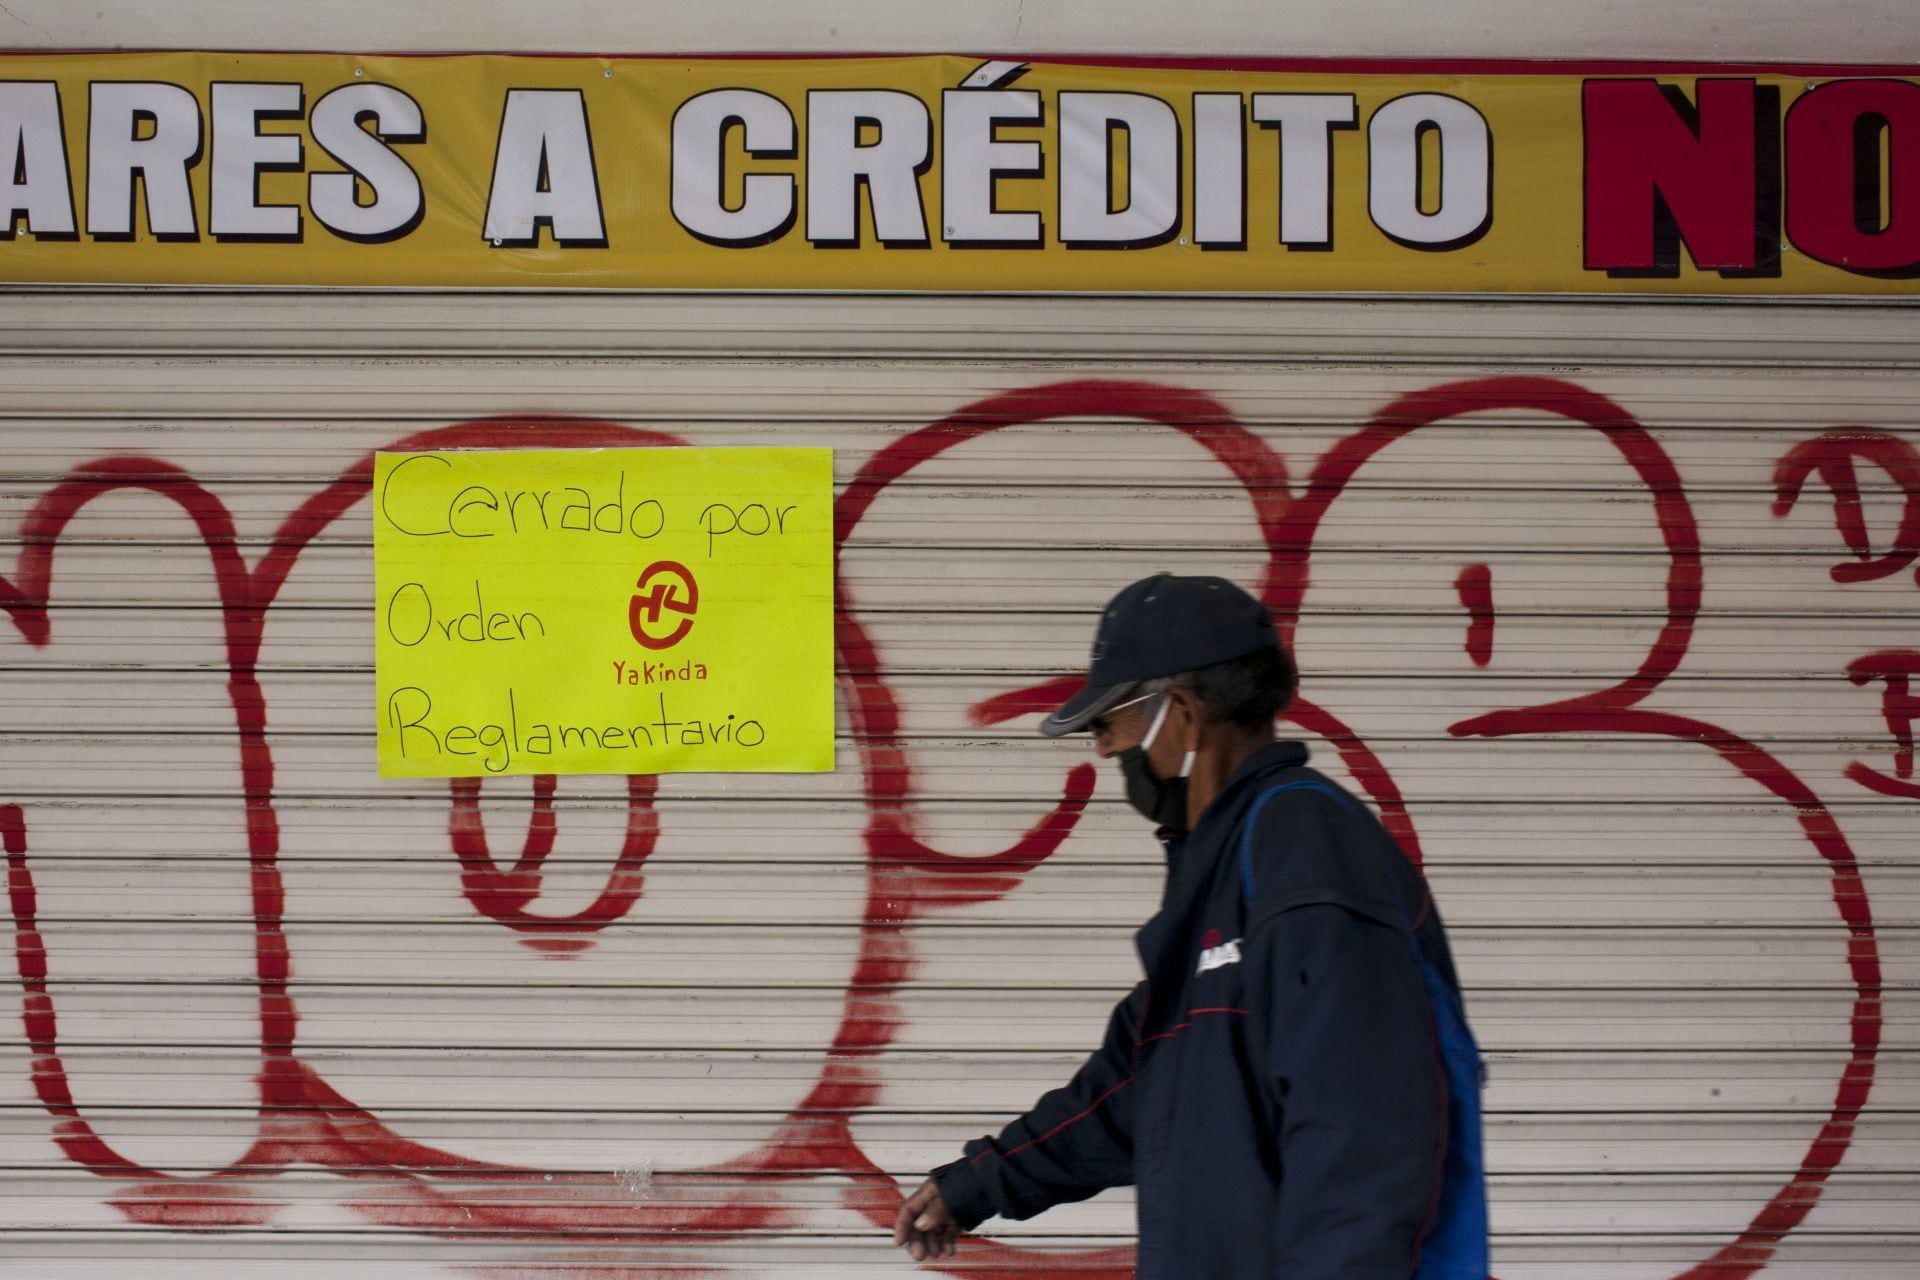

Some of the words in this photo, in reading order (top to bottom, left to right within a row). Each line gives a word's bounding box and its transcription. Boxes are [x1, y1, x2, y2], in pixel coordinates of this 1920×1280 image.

[481, 87, 609, 249] A
[670, 60, 1495, 252] CRÉDITO
[1581, 77, 1920, 280] NO
[381, 455, 665, 539] Cerrado
[699, 502, 798, 559] por
[387, 579, 546, 647] Orden
[388, 686, 766, 773] Reglamentario
